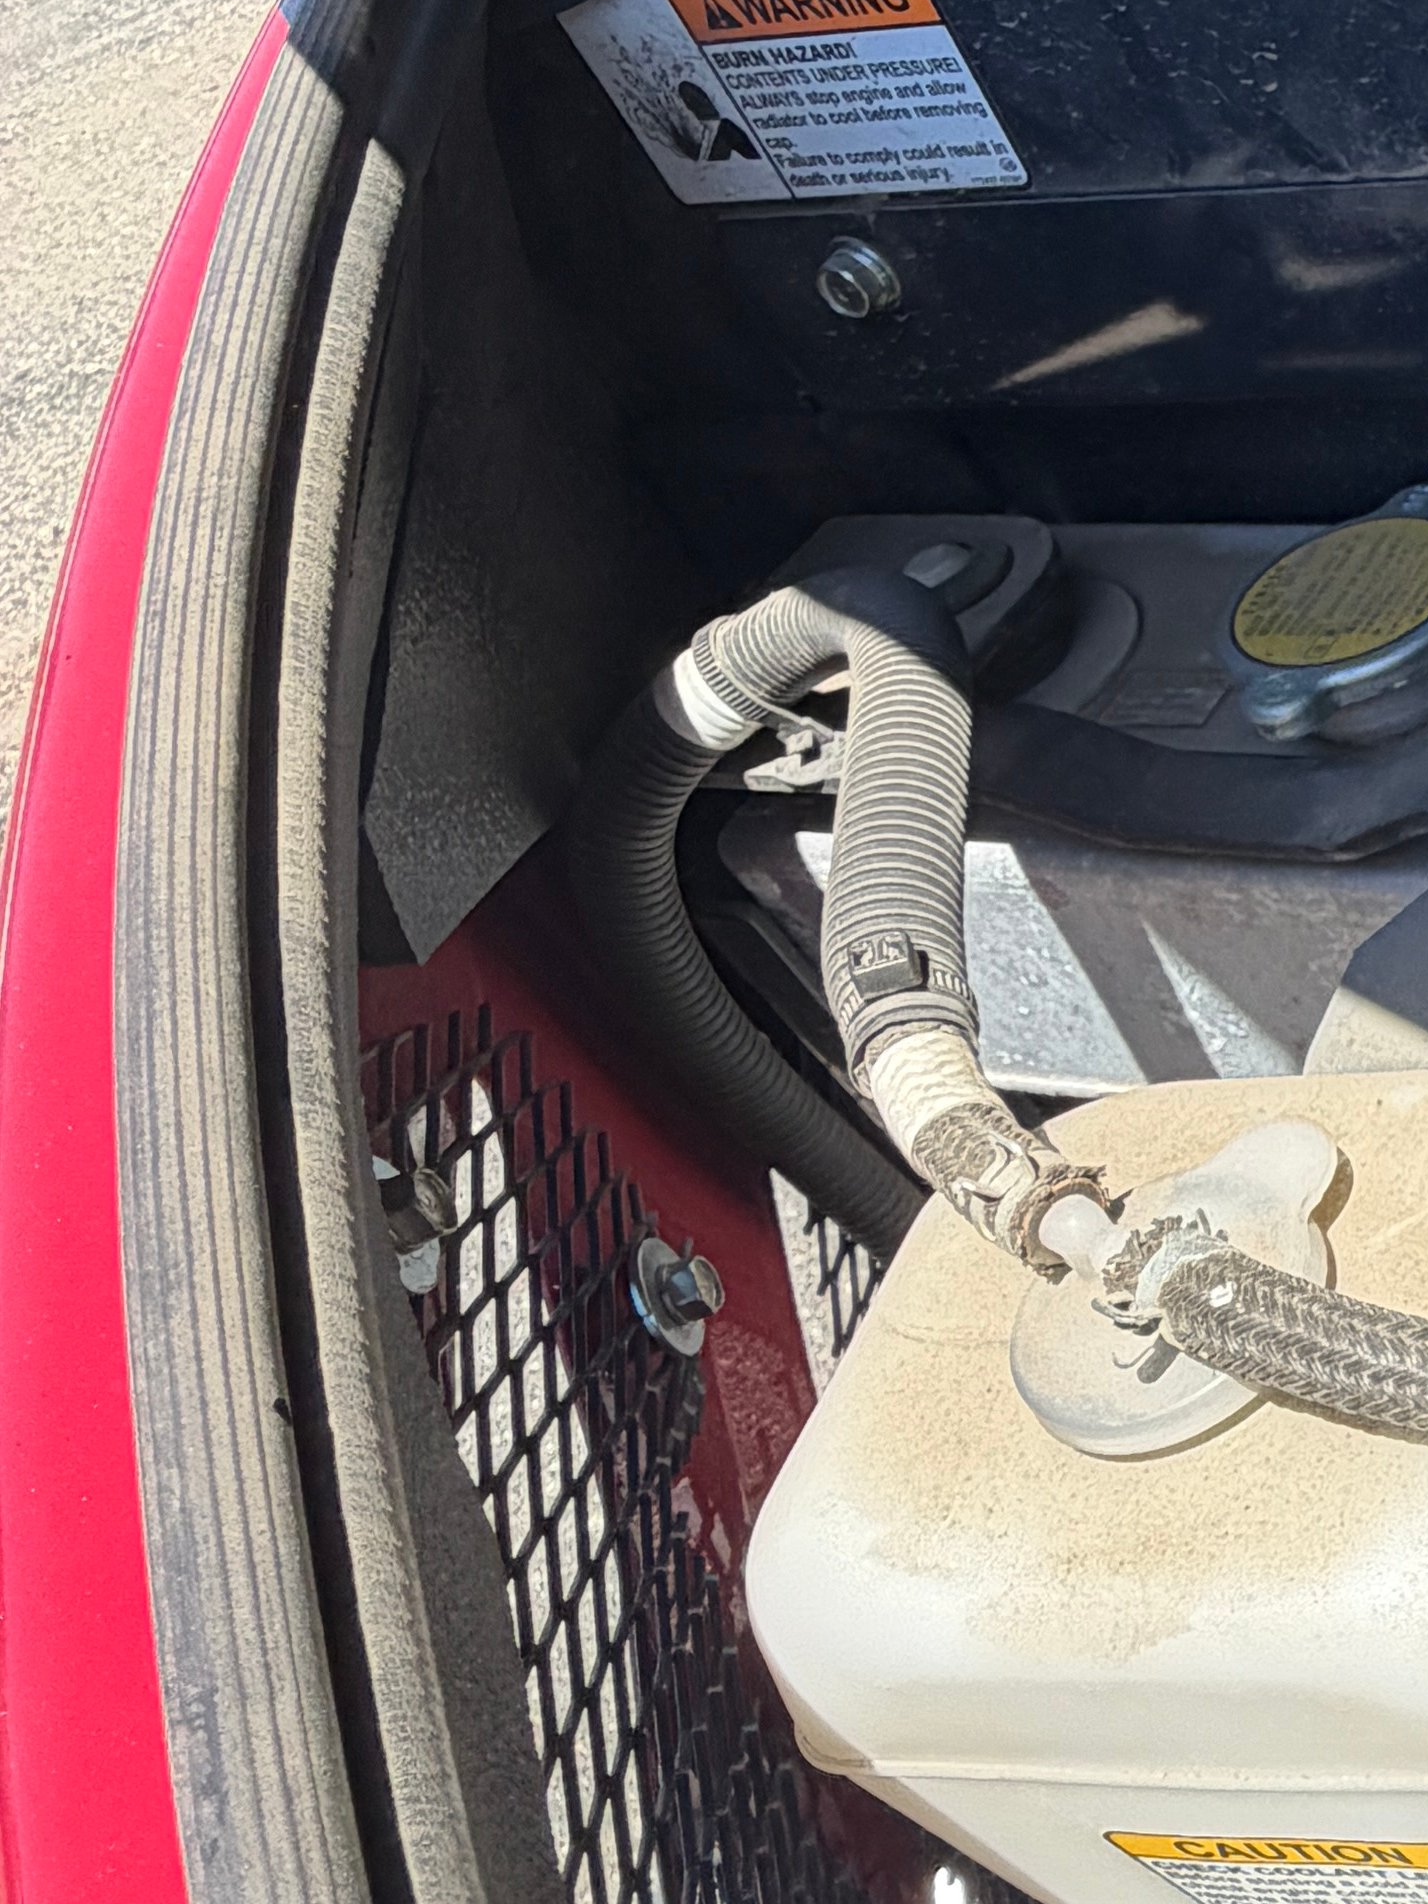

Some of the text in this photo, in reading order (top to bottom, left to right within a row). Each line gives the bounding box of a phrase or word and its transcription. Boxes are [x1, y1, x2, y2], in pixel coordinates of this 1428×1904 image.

[712, 50, 770, 69] BURN
[726, 69, 810, 89] CONTENTS
[810, 64, 869, 83] UNDER
[739, 80, 967, 109] ALWAYS stop engine and allow
[753, 100, 988, 129] radiator to cool before removing
[774, 139, 1009, 168] Failure to comply could result in
[789, 172, 831, 187] death
[832, 174, 848, 185] or
[850, 169, 905, 183] serious
[1172, 1840, 1414, 1865] CAUTION
[1151, 1861, 1248, 1874] CHECK
[1254, 1866, 1387, 1879] COOLANT
